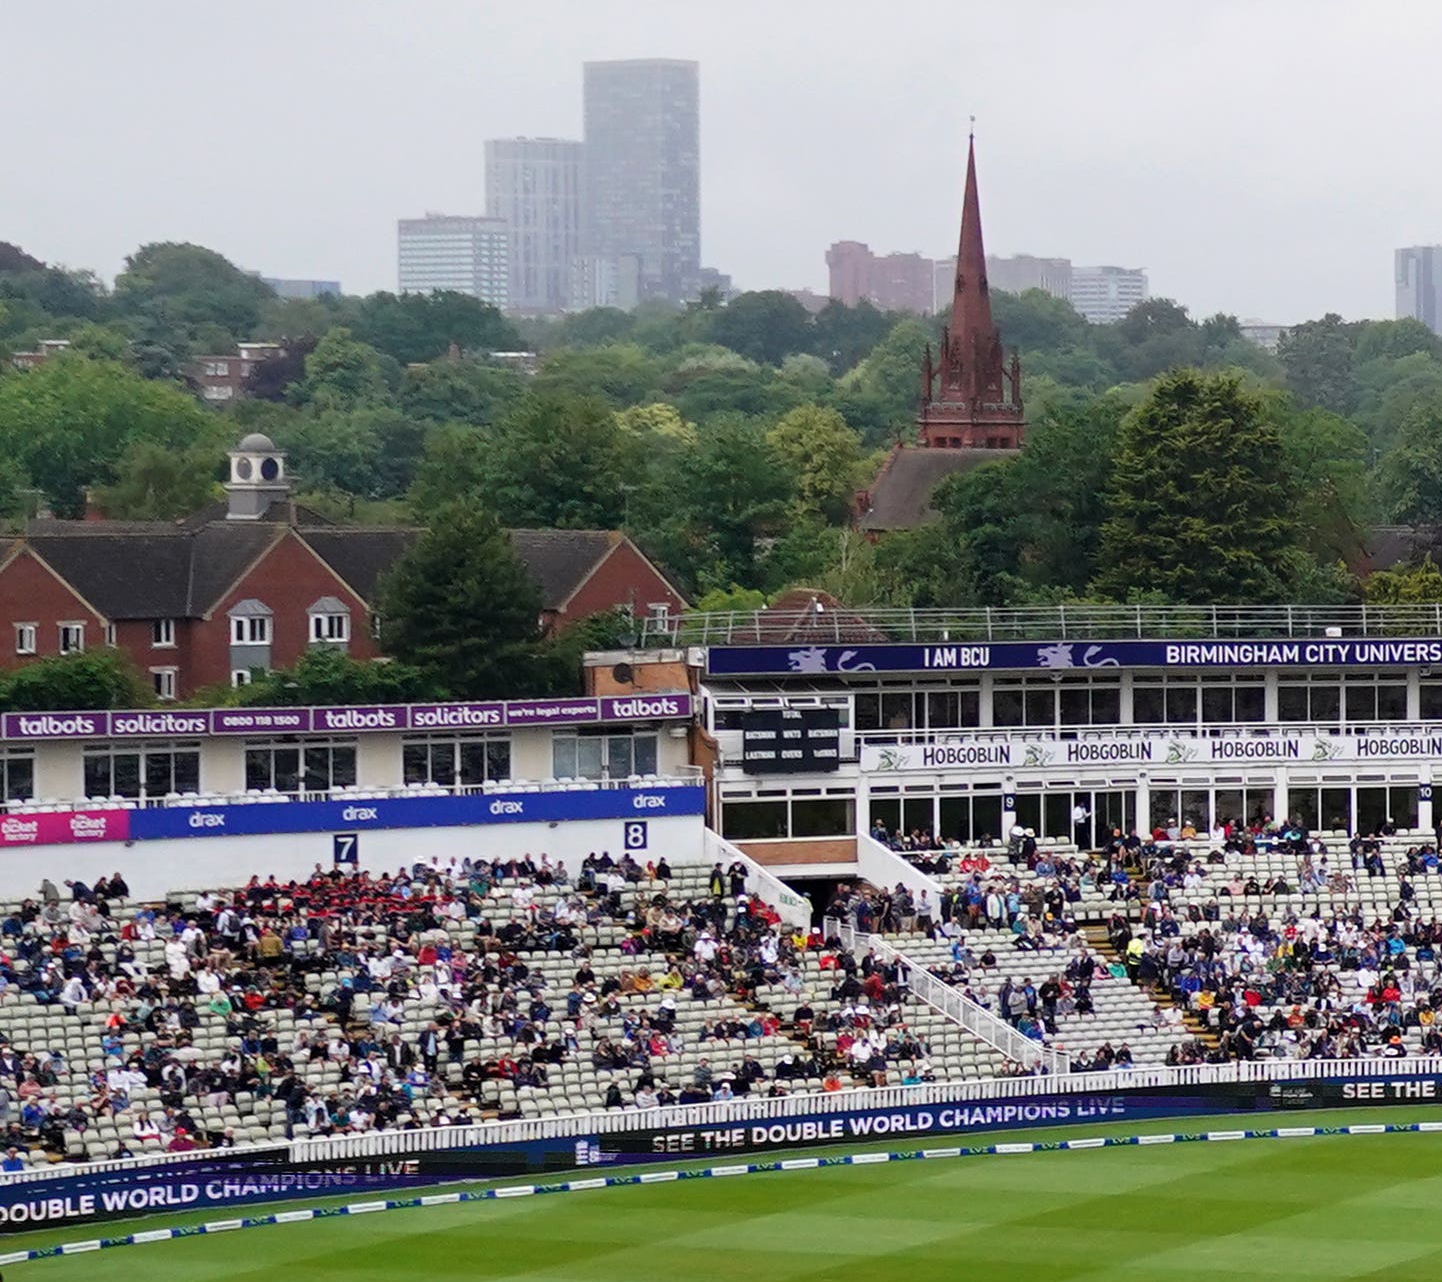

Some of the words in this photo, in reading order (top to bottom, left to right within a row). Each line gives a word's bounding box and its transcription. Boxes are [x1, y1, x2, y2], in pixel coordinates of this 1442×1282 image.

[924, 648, 929, 667] I
[932, 647, 957, 667] AM
[960, 647, 990, 667] BCU
[1166, 643, 1300, 664] BIRMINGHAM
[1304, 644, 1350, 663] CITY
[414, 706, 500, 726] solicitors
[507, 707, 535, 718] we're
[536, 706, 561, 718] legal
[561, 704, 597, 717] experts
[612, 697, 679, 717] talbots
[19, 715, 95, 736] talbots
[114, 713, 206, 733] solicitors
[222, 715, 253, 727] 0800
[254, 715, 272, 727] 118
[273, 715, 300, 727] 1500
[325, 709, 396, 728] talbots
[924, 744, 1011, 766] HOBGOBLIN
[1211, 739, 1299, 759] HOBGOBLIN
[632, 793, 667, 808] drax
[1006, 796, 1014, 808] 9
[1419, 786, 1432, 799] 10
[69, 815, 107, 830] ticket
[188, 811, 226, 828] drax
[342, 805, 378, 821] drax
[1, 819, 38, 834] ticket
[73, 828, 106, 839] factory
[627, 824, 644, 847] 8
[337, 837, 355, 860] 7
[1342, 1082, 1385, 1100] SEE
[1394, 1080, 1435, 1098] THE
[752, 1119, 844, 1144] DOUBLE
[849, 1111, 934, 1136] WORLD
[939, 1101, 1071, 1127] CHAMPIONS
[100, 1181, 199, 1211] WORLD
